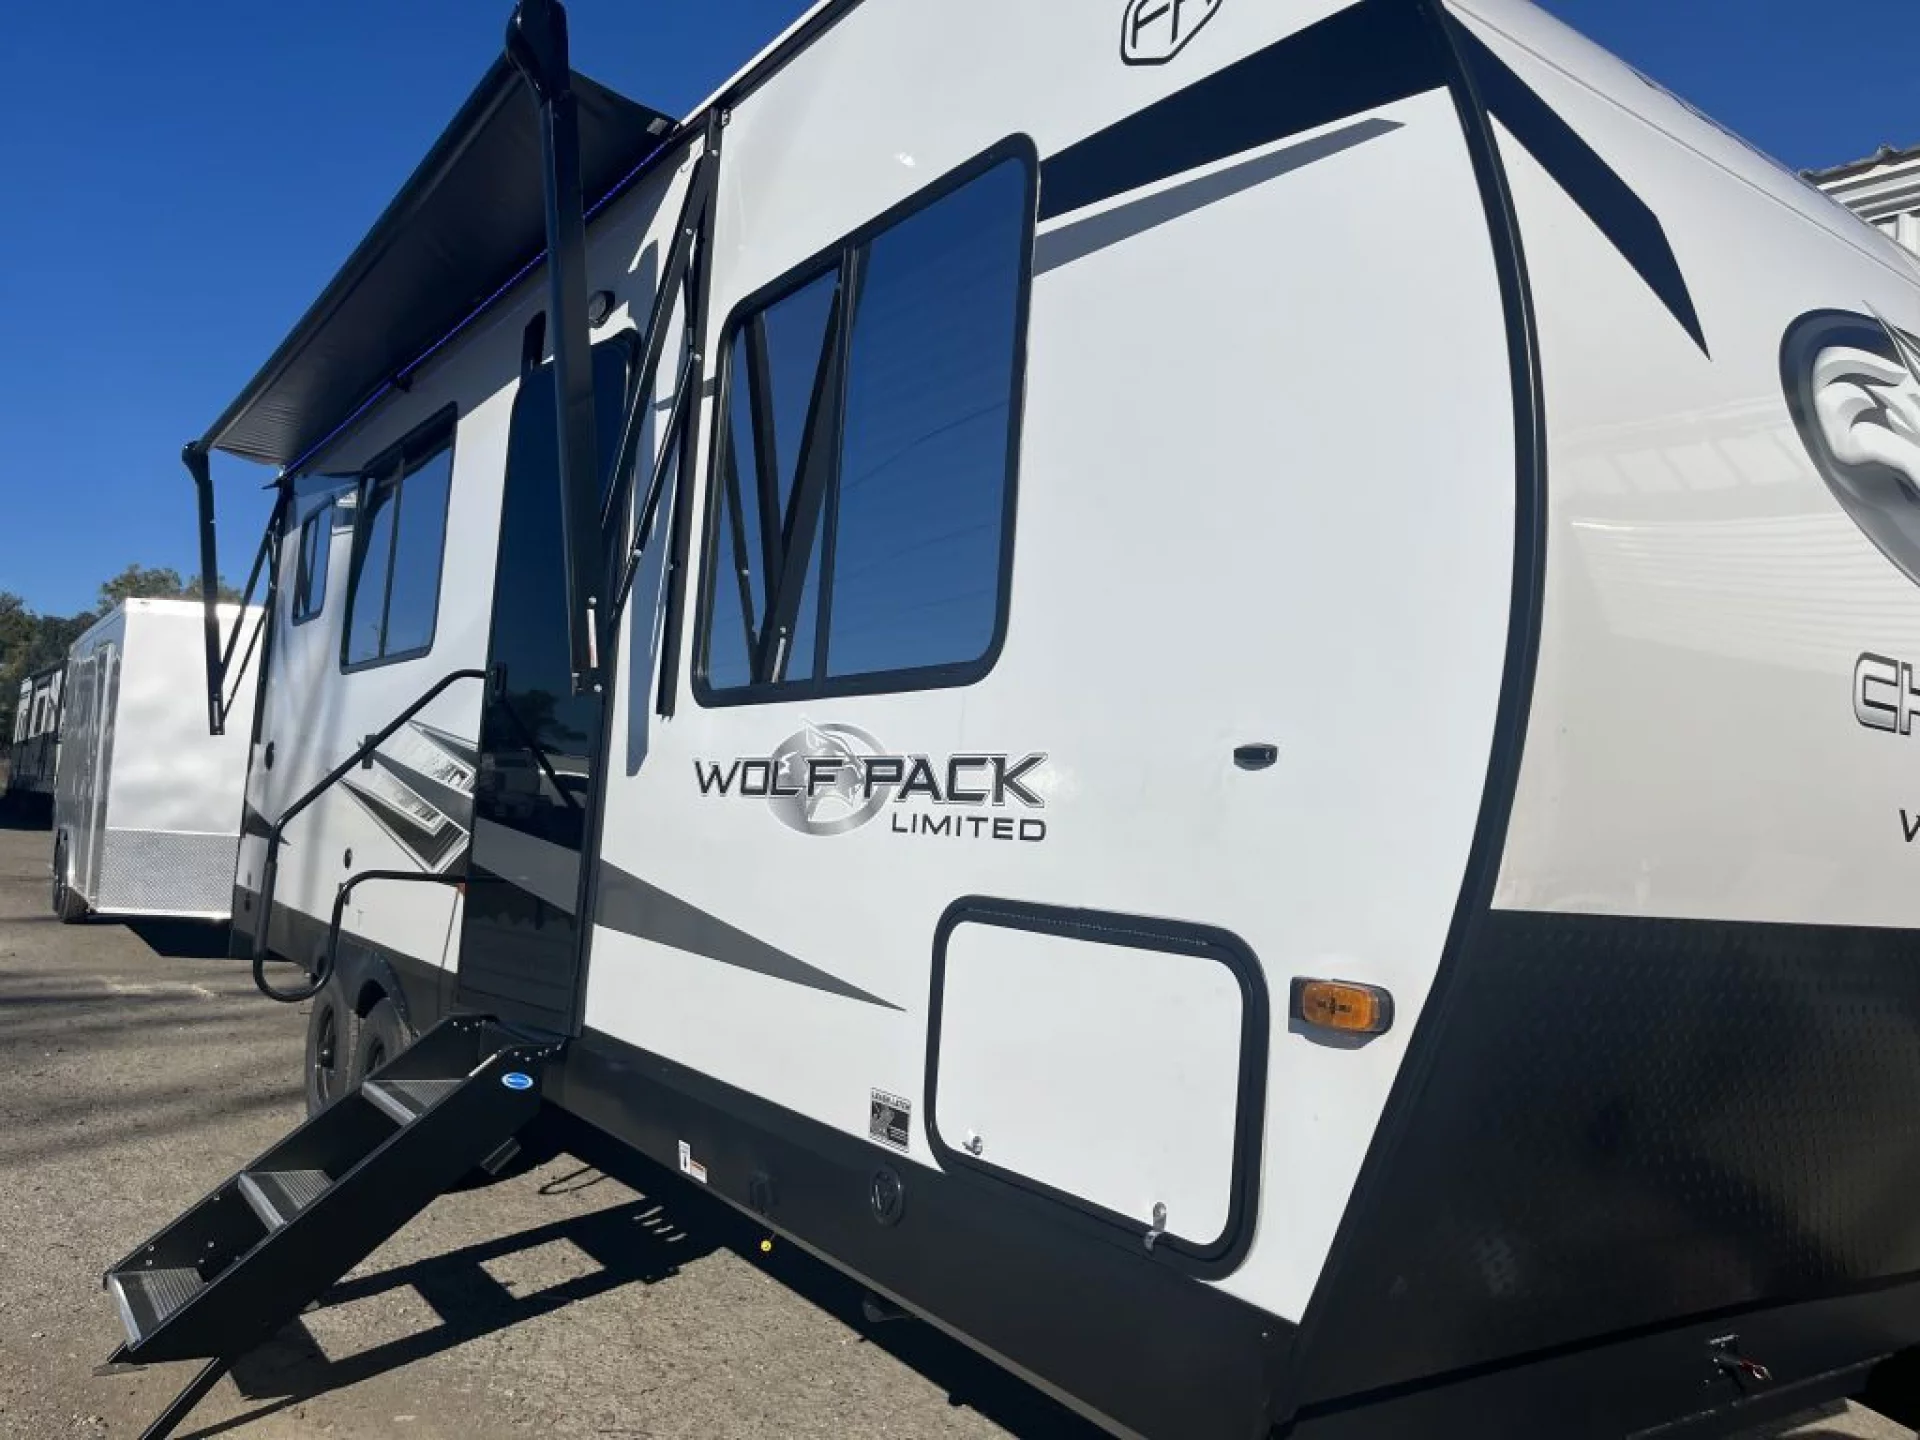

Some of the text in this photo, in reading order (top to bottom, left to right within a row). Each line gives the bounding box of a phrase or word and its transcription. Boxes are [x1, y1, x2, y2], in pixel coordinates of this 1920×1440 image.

[692, 752, 1048, 808] WOLF PACK
[892, 812, 1046, 842] LIMITED
